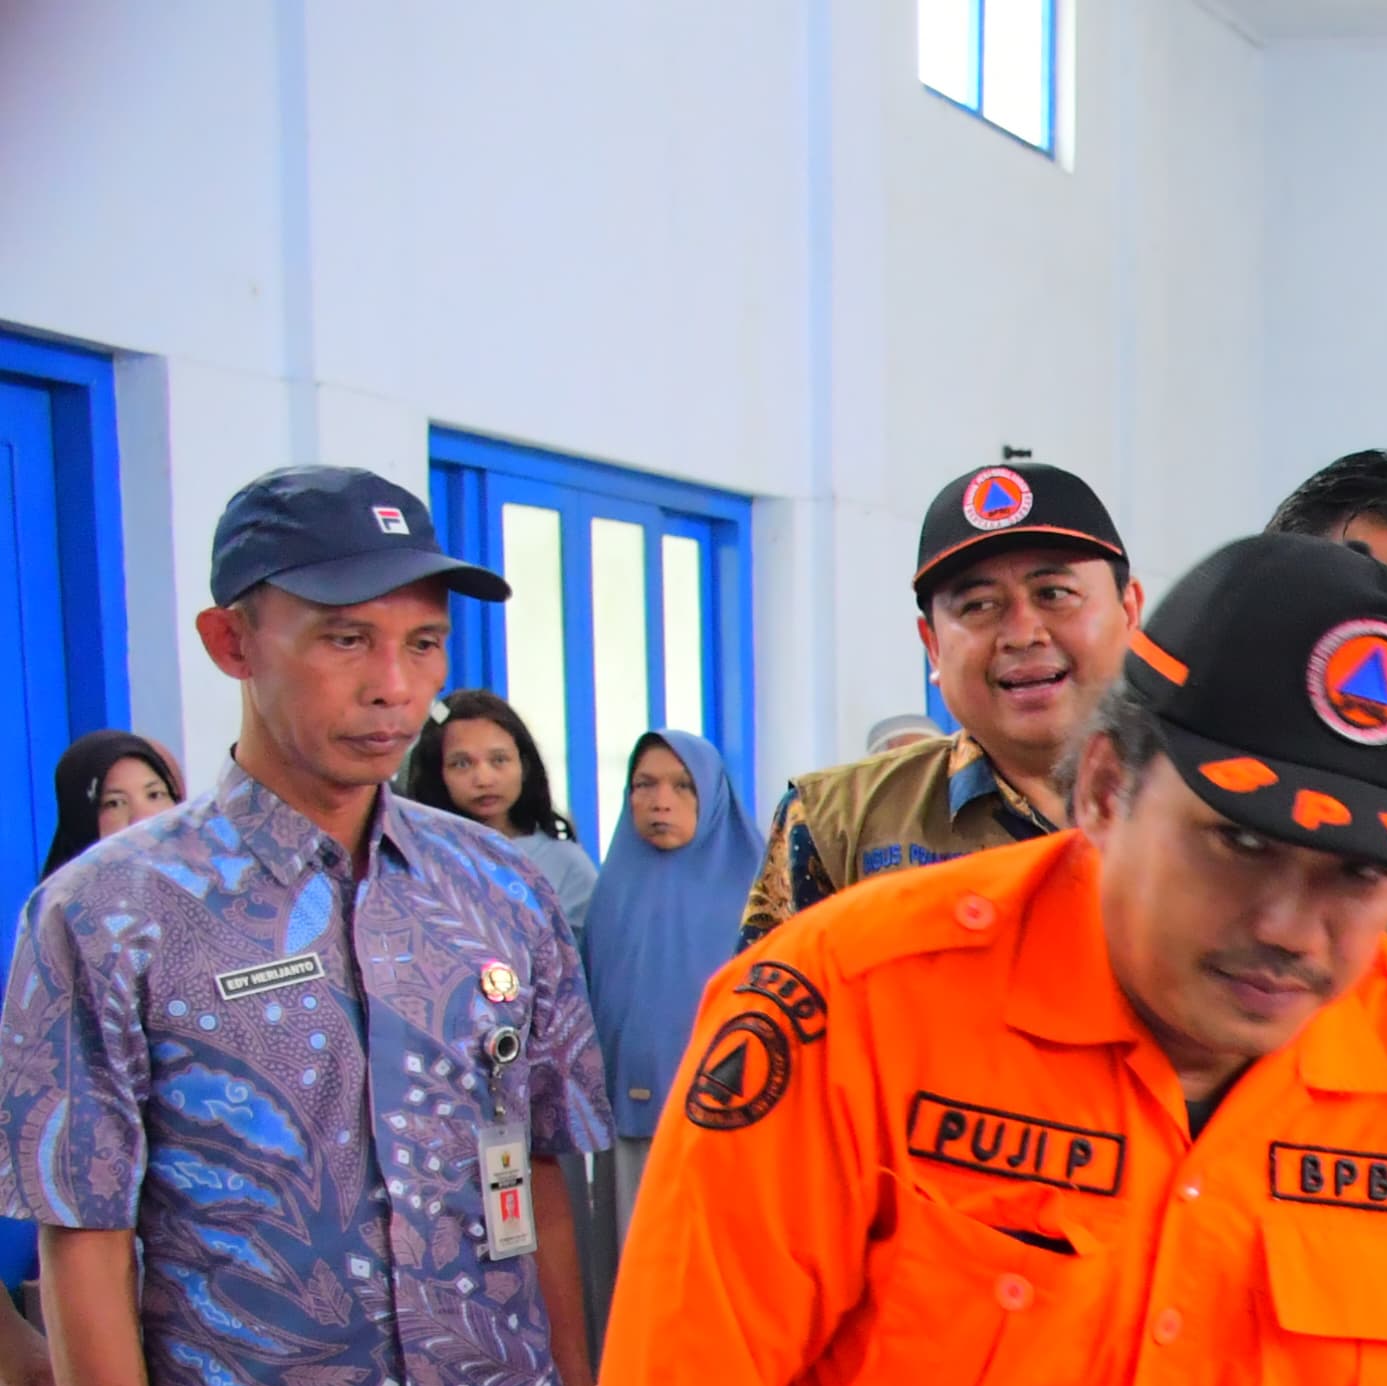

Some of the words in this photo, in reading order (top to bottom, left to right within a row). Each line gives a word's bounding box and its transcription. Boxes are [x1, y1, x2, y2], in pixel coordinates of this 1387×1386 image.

[226, 976, 249, 990] EDY
[935, 1110, 1047, 1173] PUJI
[1066, 1138, 1093, 1178] P
